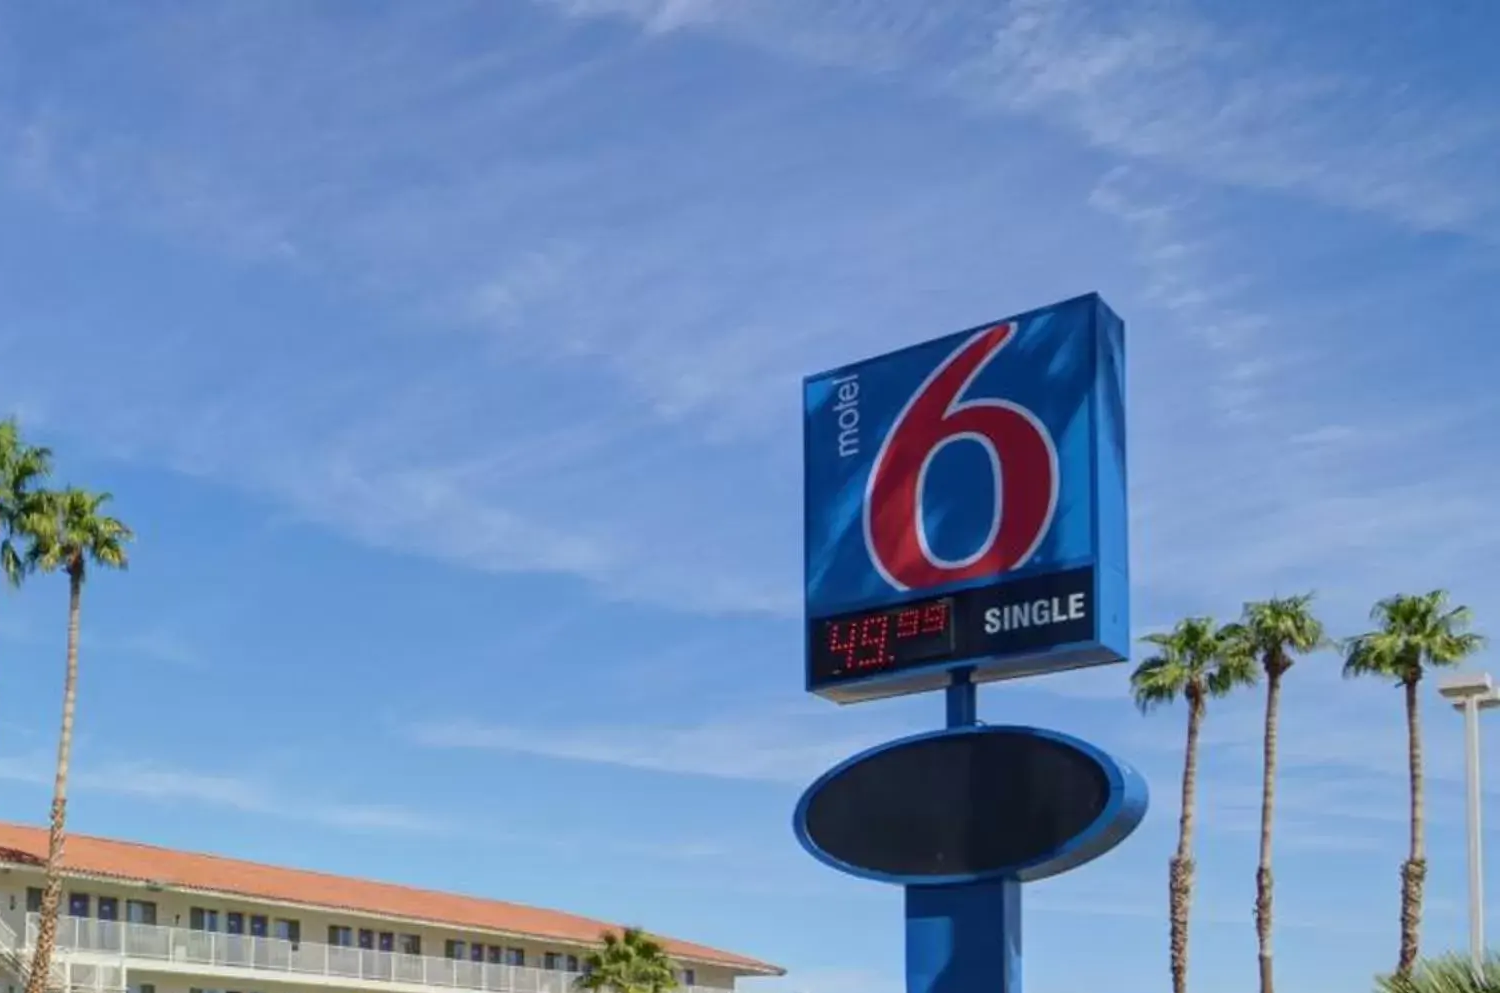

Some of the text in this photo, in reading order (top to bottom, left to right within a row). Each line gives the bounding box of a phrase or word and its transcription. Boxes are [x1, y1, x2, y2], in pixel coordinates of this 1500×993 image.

[832, 374, 860, 457] motel
[864, 321, 1059, 591] 6
[984, 593, 1085, 634] SINGLE
